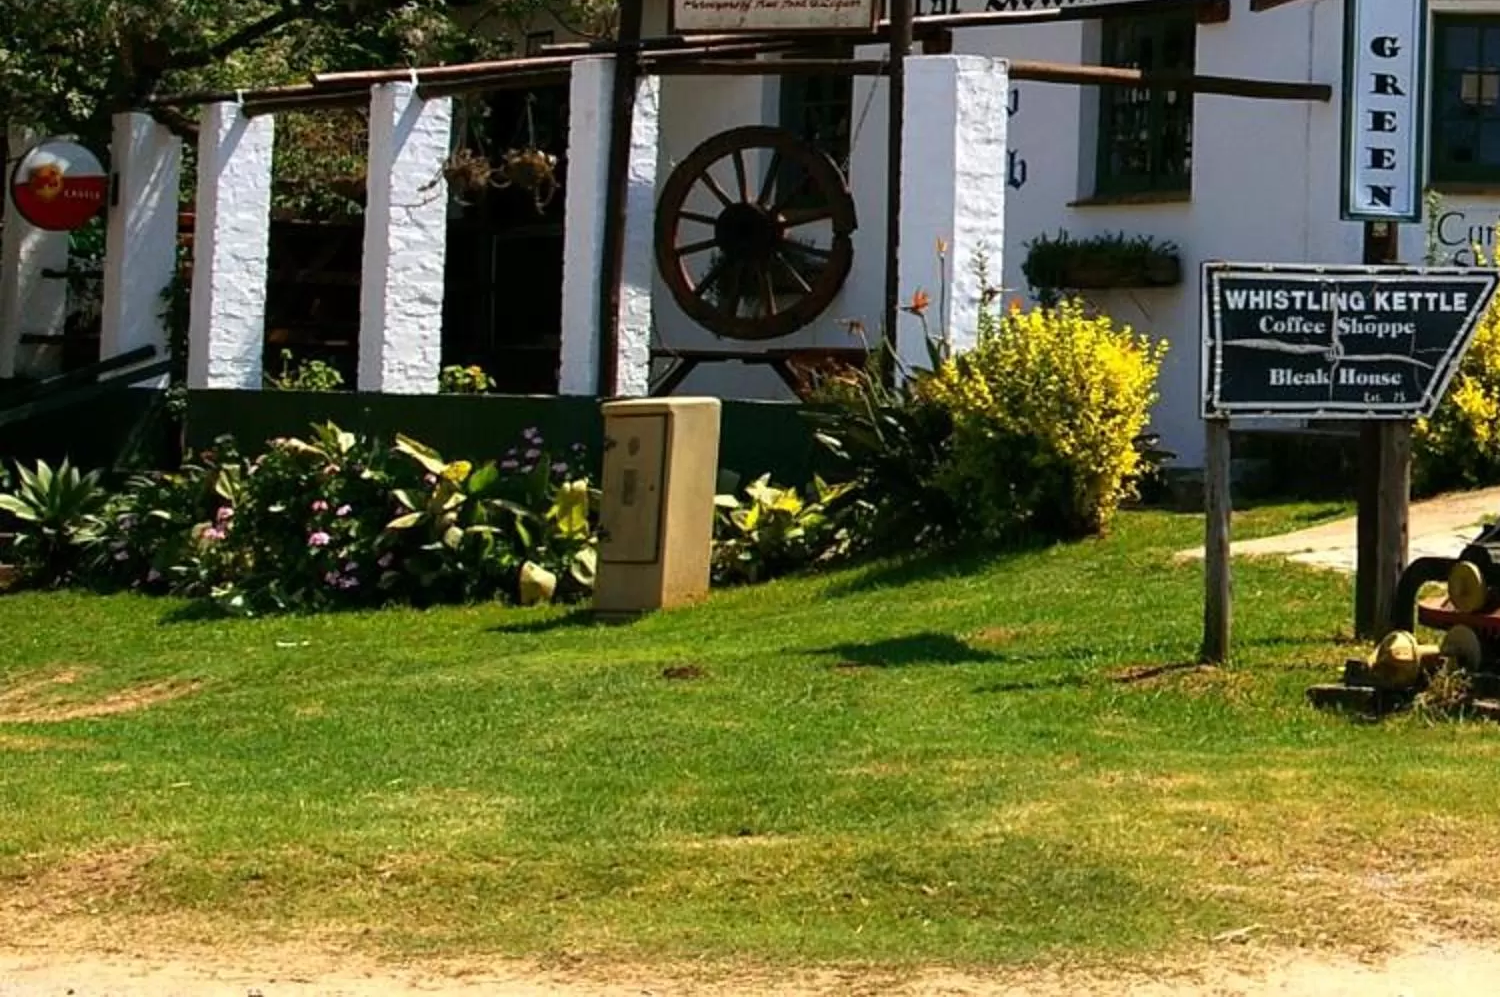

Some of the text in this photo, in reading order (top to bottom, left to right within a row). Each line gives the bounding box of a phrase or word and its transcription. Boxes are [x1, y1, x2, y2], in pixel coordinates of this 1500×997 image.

[1365, 36, 1405, 208] GREEN
[1225, 289, 1467, 311] WHISTLING KETTLE
[1259, 316, 1326, 334] Coffee
[1269, 368, 1402, 386] Bleak House
